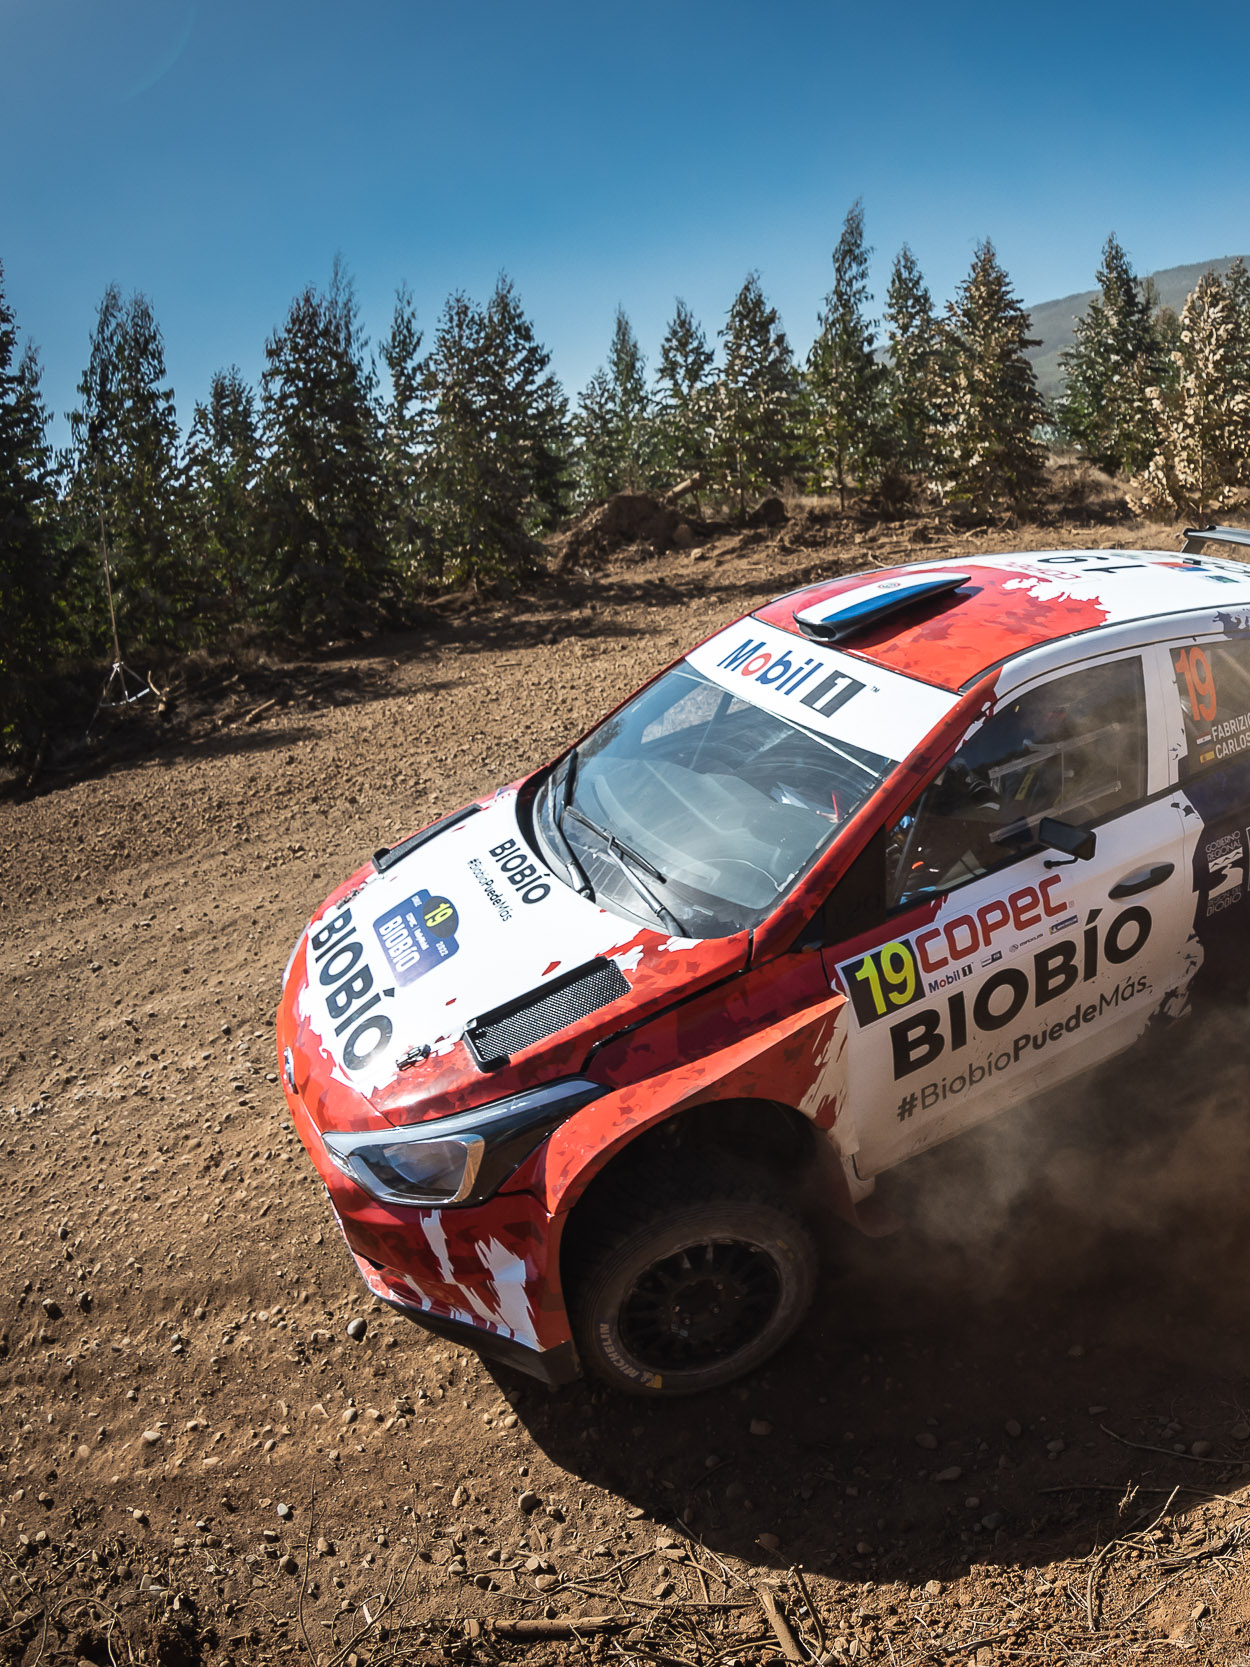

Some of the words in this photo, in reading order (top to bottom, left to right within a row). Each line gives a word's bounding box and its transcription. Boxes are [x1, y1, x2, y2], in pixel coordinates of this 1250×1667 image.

[716, 638, 825, 696] Mobil
[809, 675, 856, 713] 1
[1174, 646, 1217, 722] 19
[488, 838, 552, 905] BIOBÍO
[1205, 830, 1241, 853] GOBIERNO
[1206, 839, 1242, 862] REGIONAL
[378, 915, 421, 973] BIOBÍO
[424, 902, 454, 928] 19
[310, 908, 397, 1072] BIOBÍO
[854, 941, 918, 1016] 19
[889, 905, 1153, 1081] BIOBÍO
[928, 969, 961, 994] Mobil
[896, 974, 1150, 1122] #BiobíoPuedeMás
[600, 1323, 641, 1379] MICHELIN
